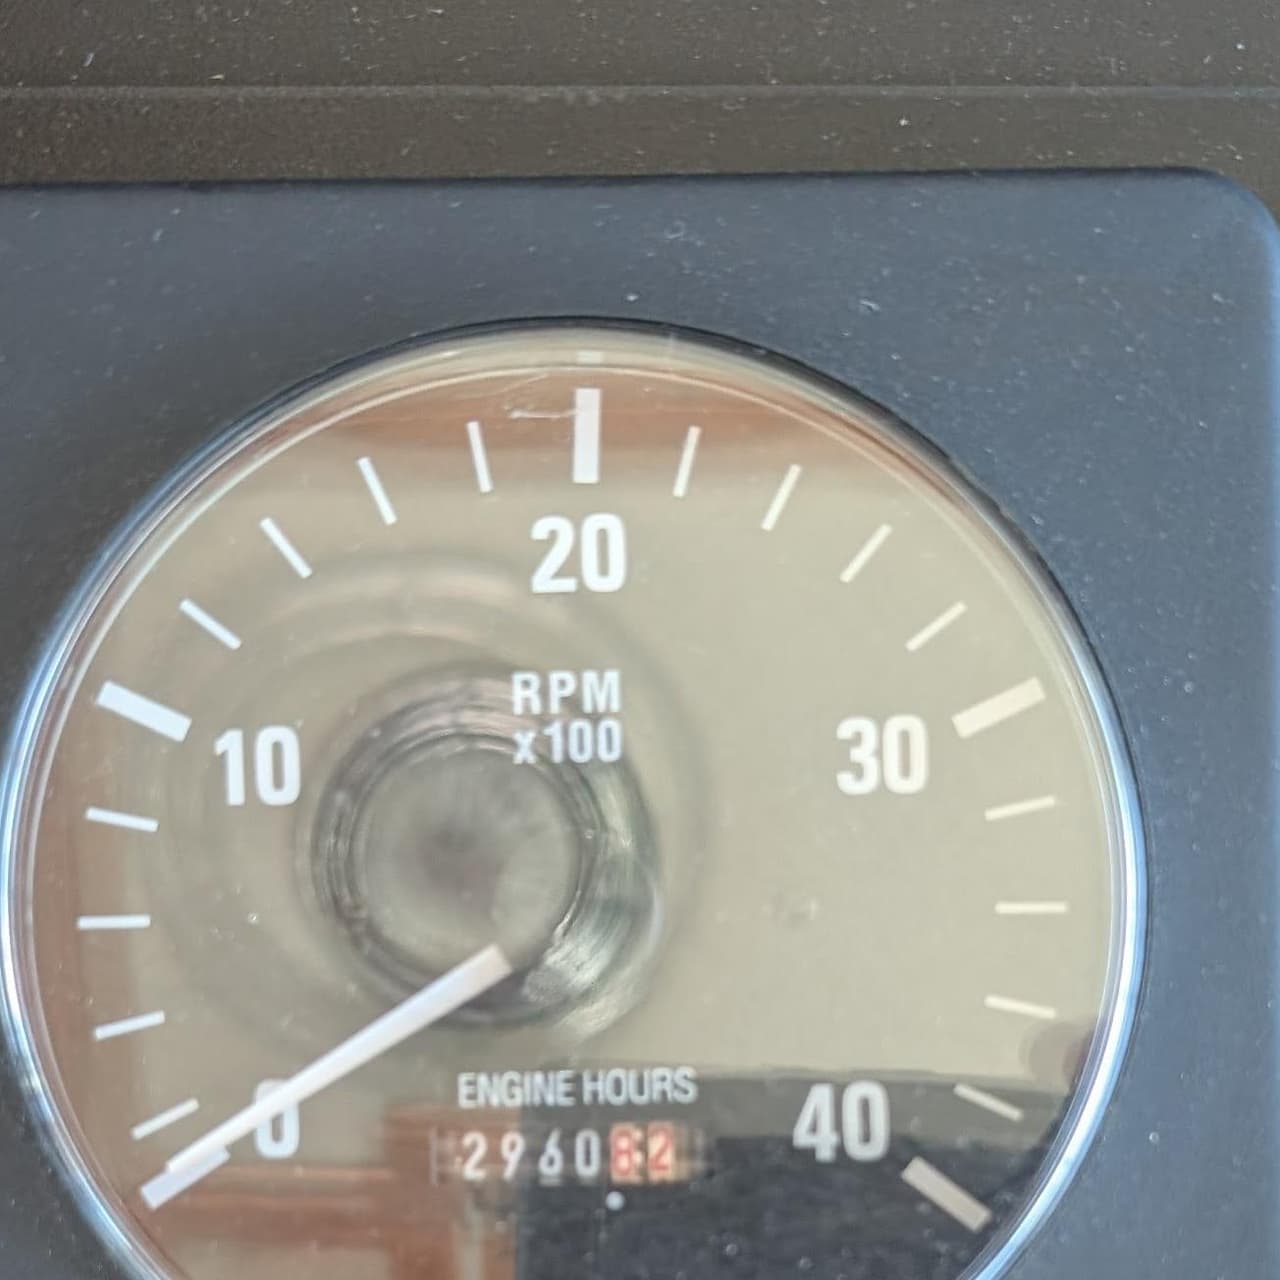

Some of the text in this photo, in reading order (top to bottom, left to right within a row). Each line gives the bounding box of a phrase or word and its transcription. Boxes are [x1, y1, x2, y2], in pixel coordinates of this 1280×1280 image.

[530, 512, 628, 594] 20
[511, 670, 622, 715] RPM
[214, 725, 302, 806] 10
[835, 715, 928, 795] 30
[253, 1080, 301, 1159] 0
[458, 1066, 698, 1109] ENGINE HOURS
[792, 1081, 889, 1162] 40
